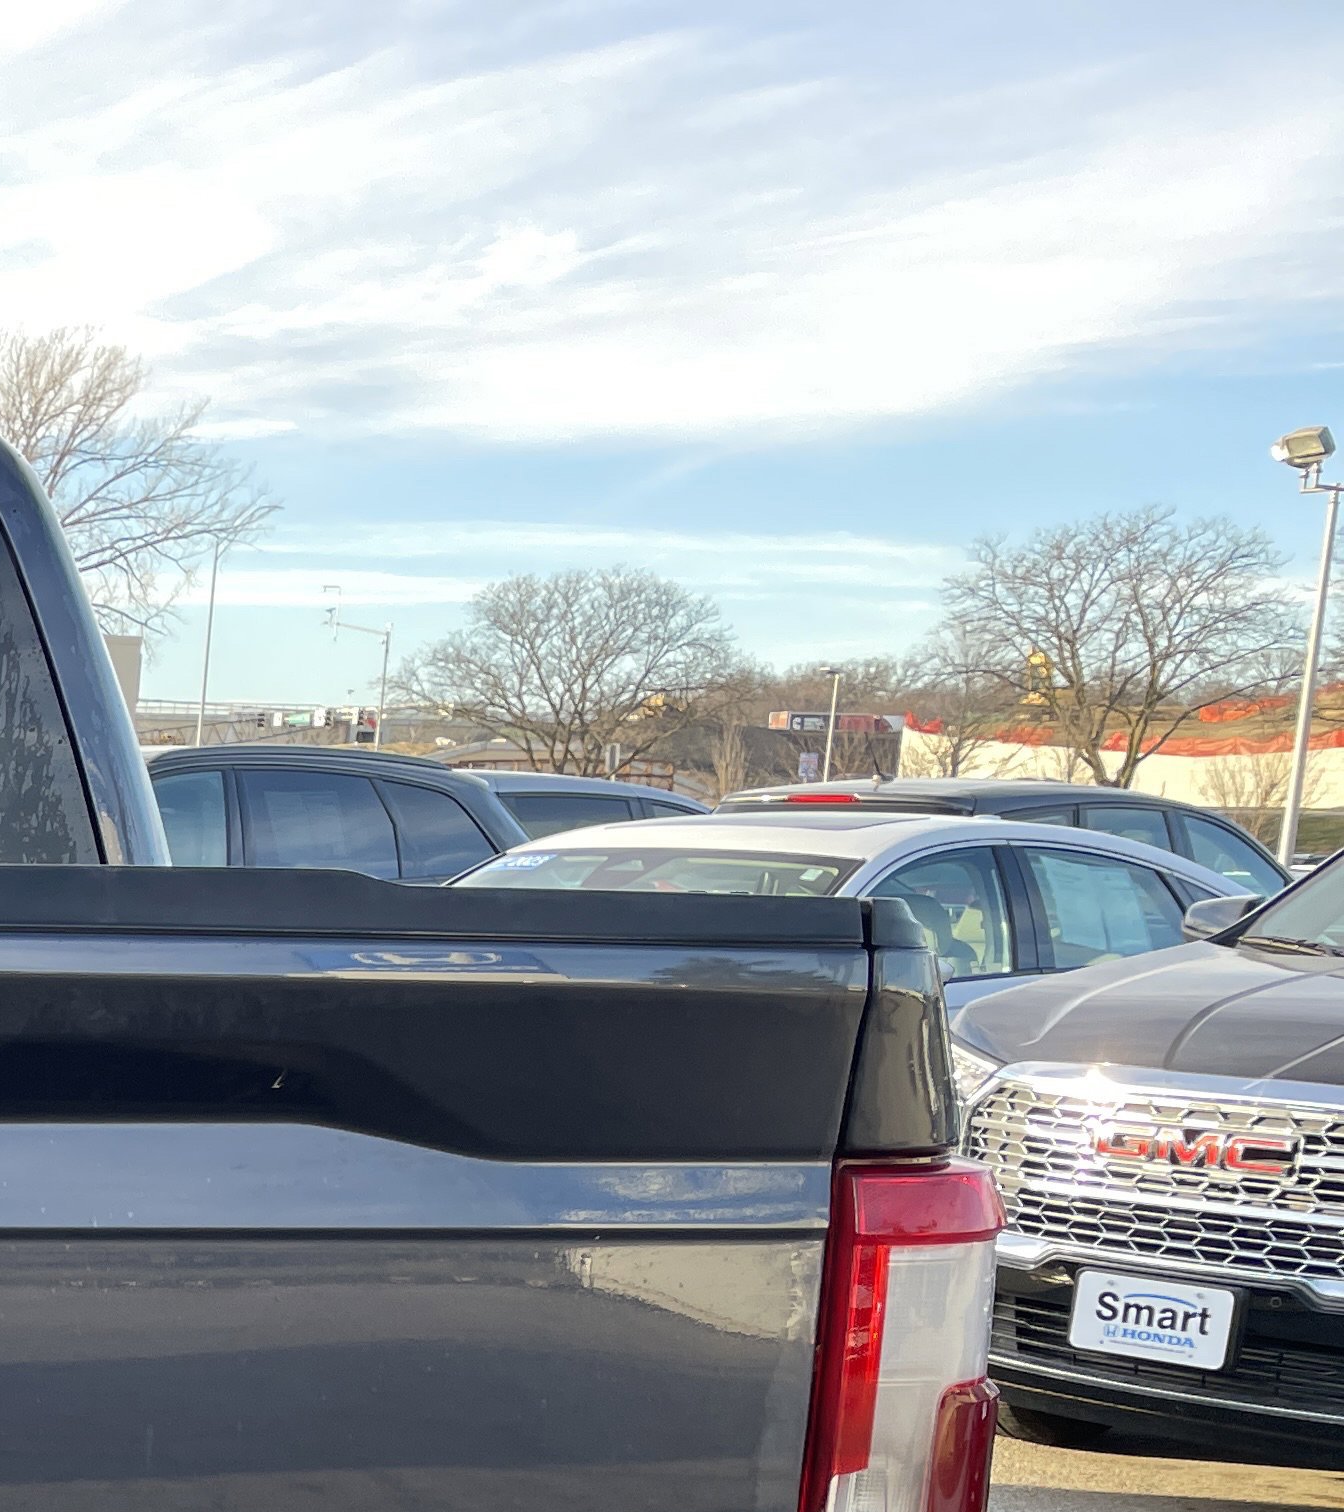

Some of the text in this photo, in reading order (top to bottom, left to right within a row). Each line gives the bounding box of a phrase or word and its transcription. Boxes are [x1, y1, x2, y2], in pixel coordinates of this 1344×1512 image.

[1094, 1128, 1294, 1176] GMC
[1095, 1291, 1212, 1335] Smart
[1121, 1328, 1195, 1348] HONDA
